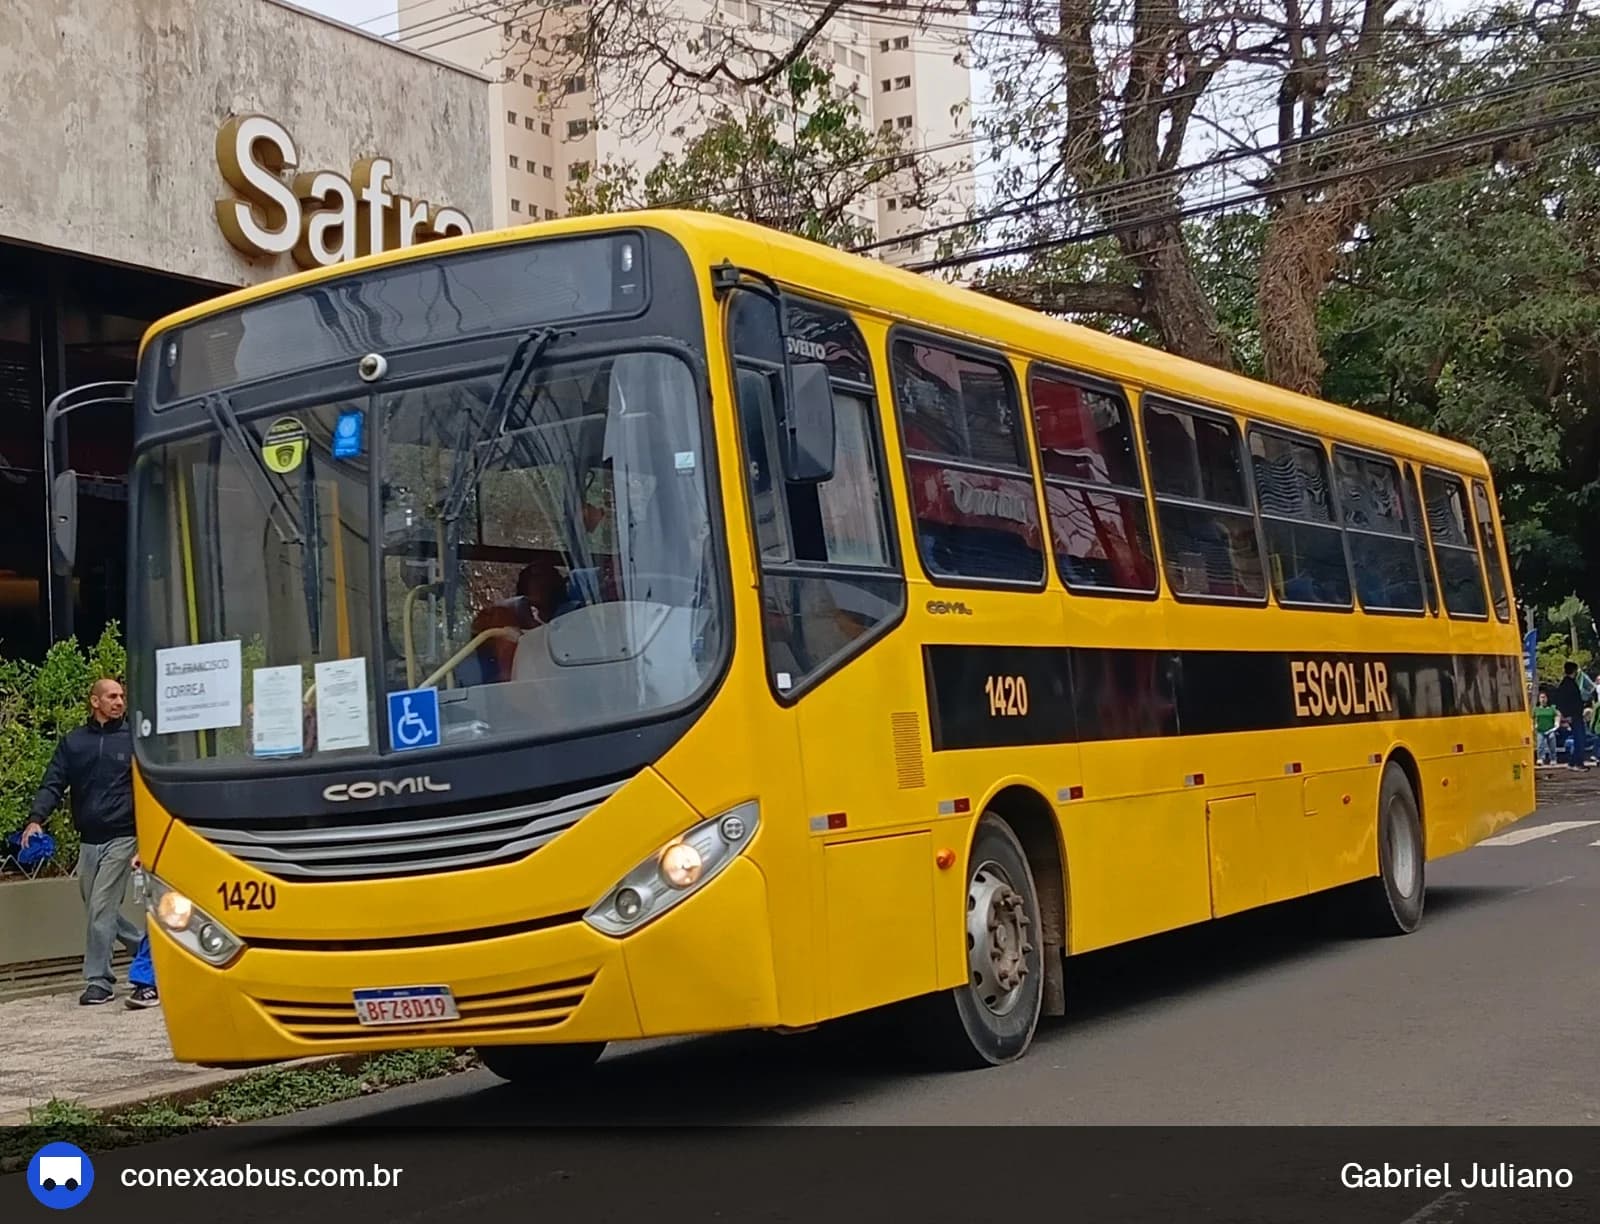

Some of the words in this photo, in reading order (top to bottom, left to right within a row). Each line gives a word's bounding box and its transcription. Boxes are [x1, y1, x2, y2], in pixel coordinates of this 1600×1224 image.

[164, 682, 206, 699] CORREA
[985, 675, 1029, 716] 1420
[1290, 660, 1393, 717] ESCOLAR
[323, 776, 451, 801] COMIL
[217, 880, 276, 911] 1420
[366, 997, 446, 1021] BFZ8D19
